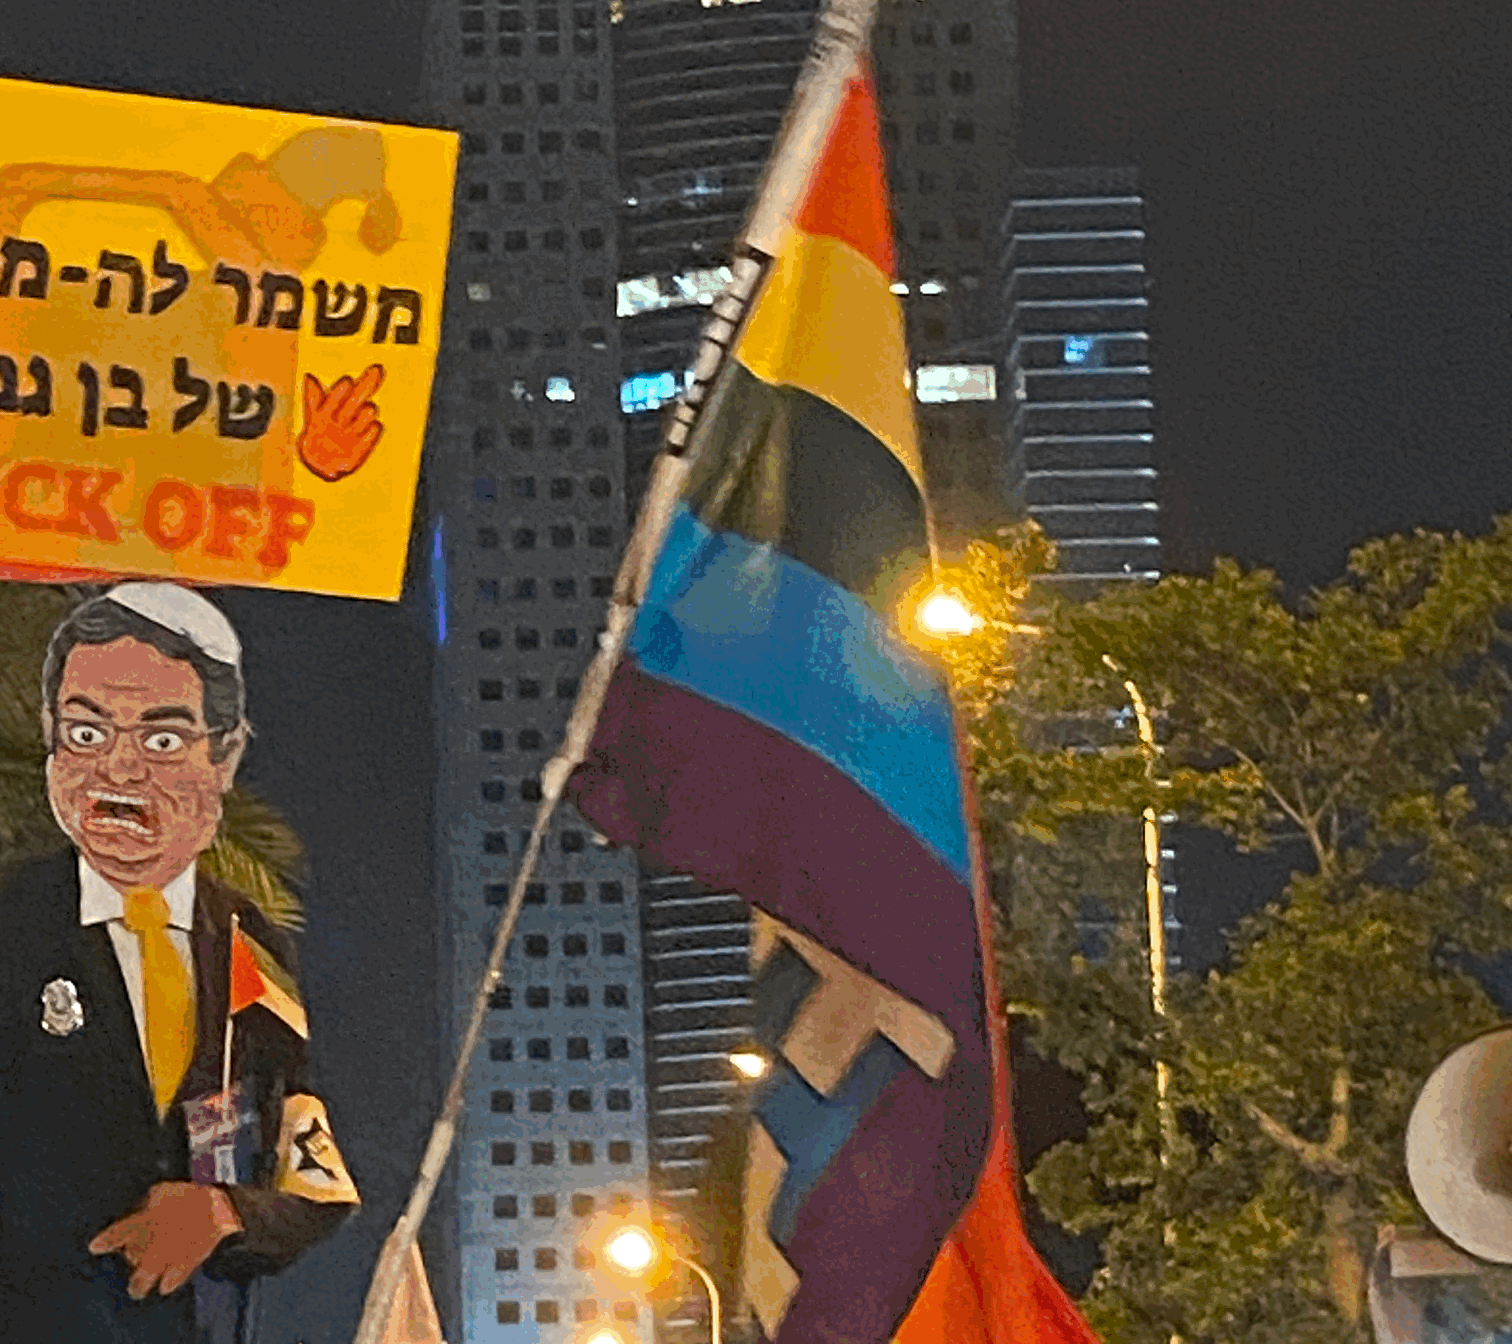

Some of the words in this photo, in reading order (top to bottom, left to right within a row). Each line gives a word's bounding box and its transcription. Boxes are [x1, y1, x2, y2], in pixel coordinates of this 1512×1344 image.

[213, 262, 422, 345] משמר
[78, 362, 149, 436] בן
[172, 357, 276, 440] של
[142, 476, 315, 576] OFF
